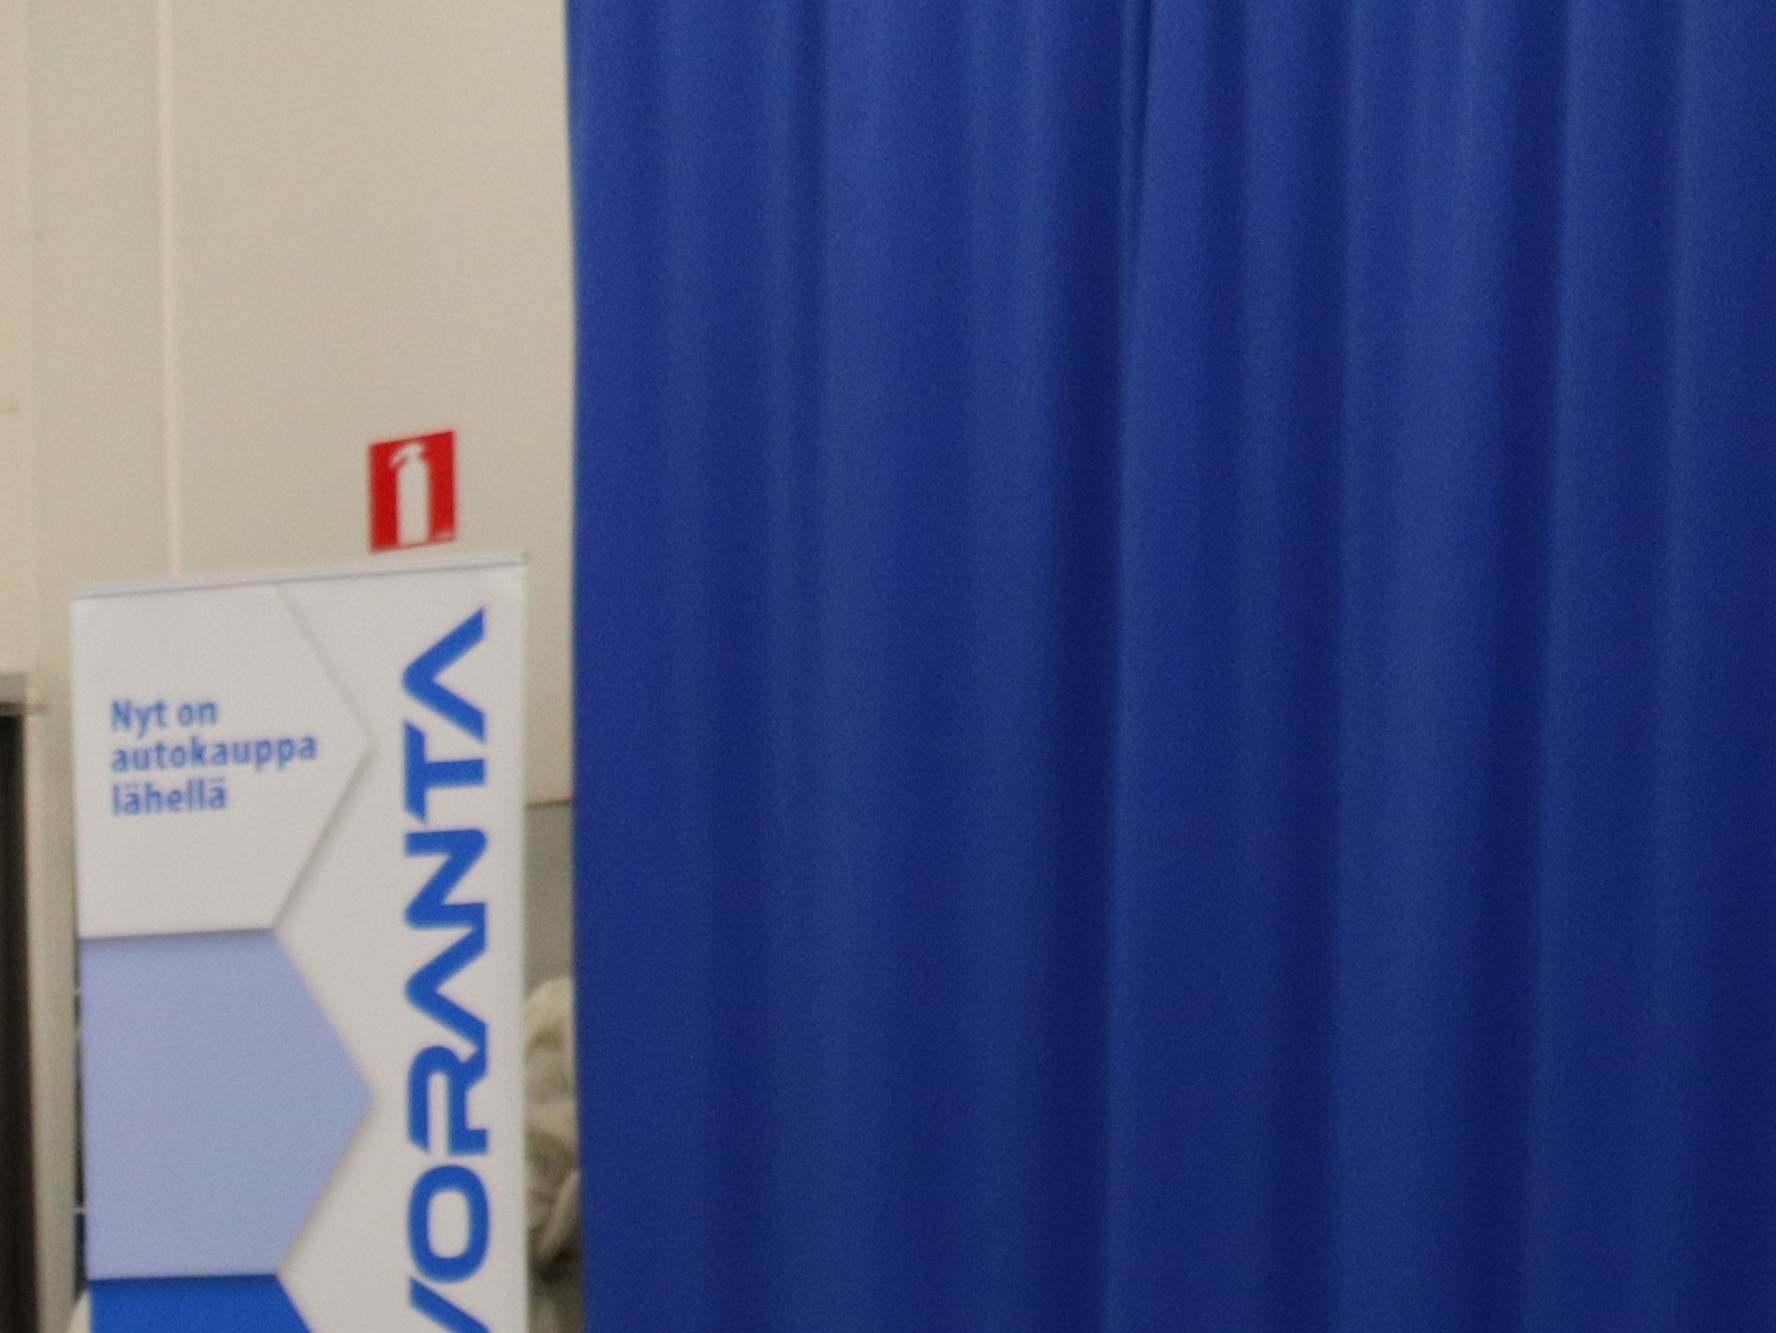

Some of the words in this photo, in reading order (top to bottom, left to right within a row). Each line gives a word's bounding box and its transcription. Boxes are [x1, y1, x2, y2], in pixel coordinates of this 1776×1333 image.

[112, 700, 167, 739] Nyt
[177, 702, 217, 727] on
[112, 735, 317, 772] autokauppa
[112, 777, 227, 816] lähellä
